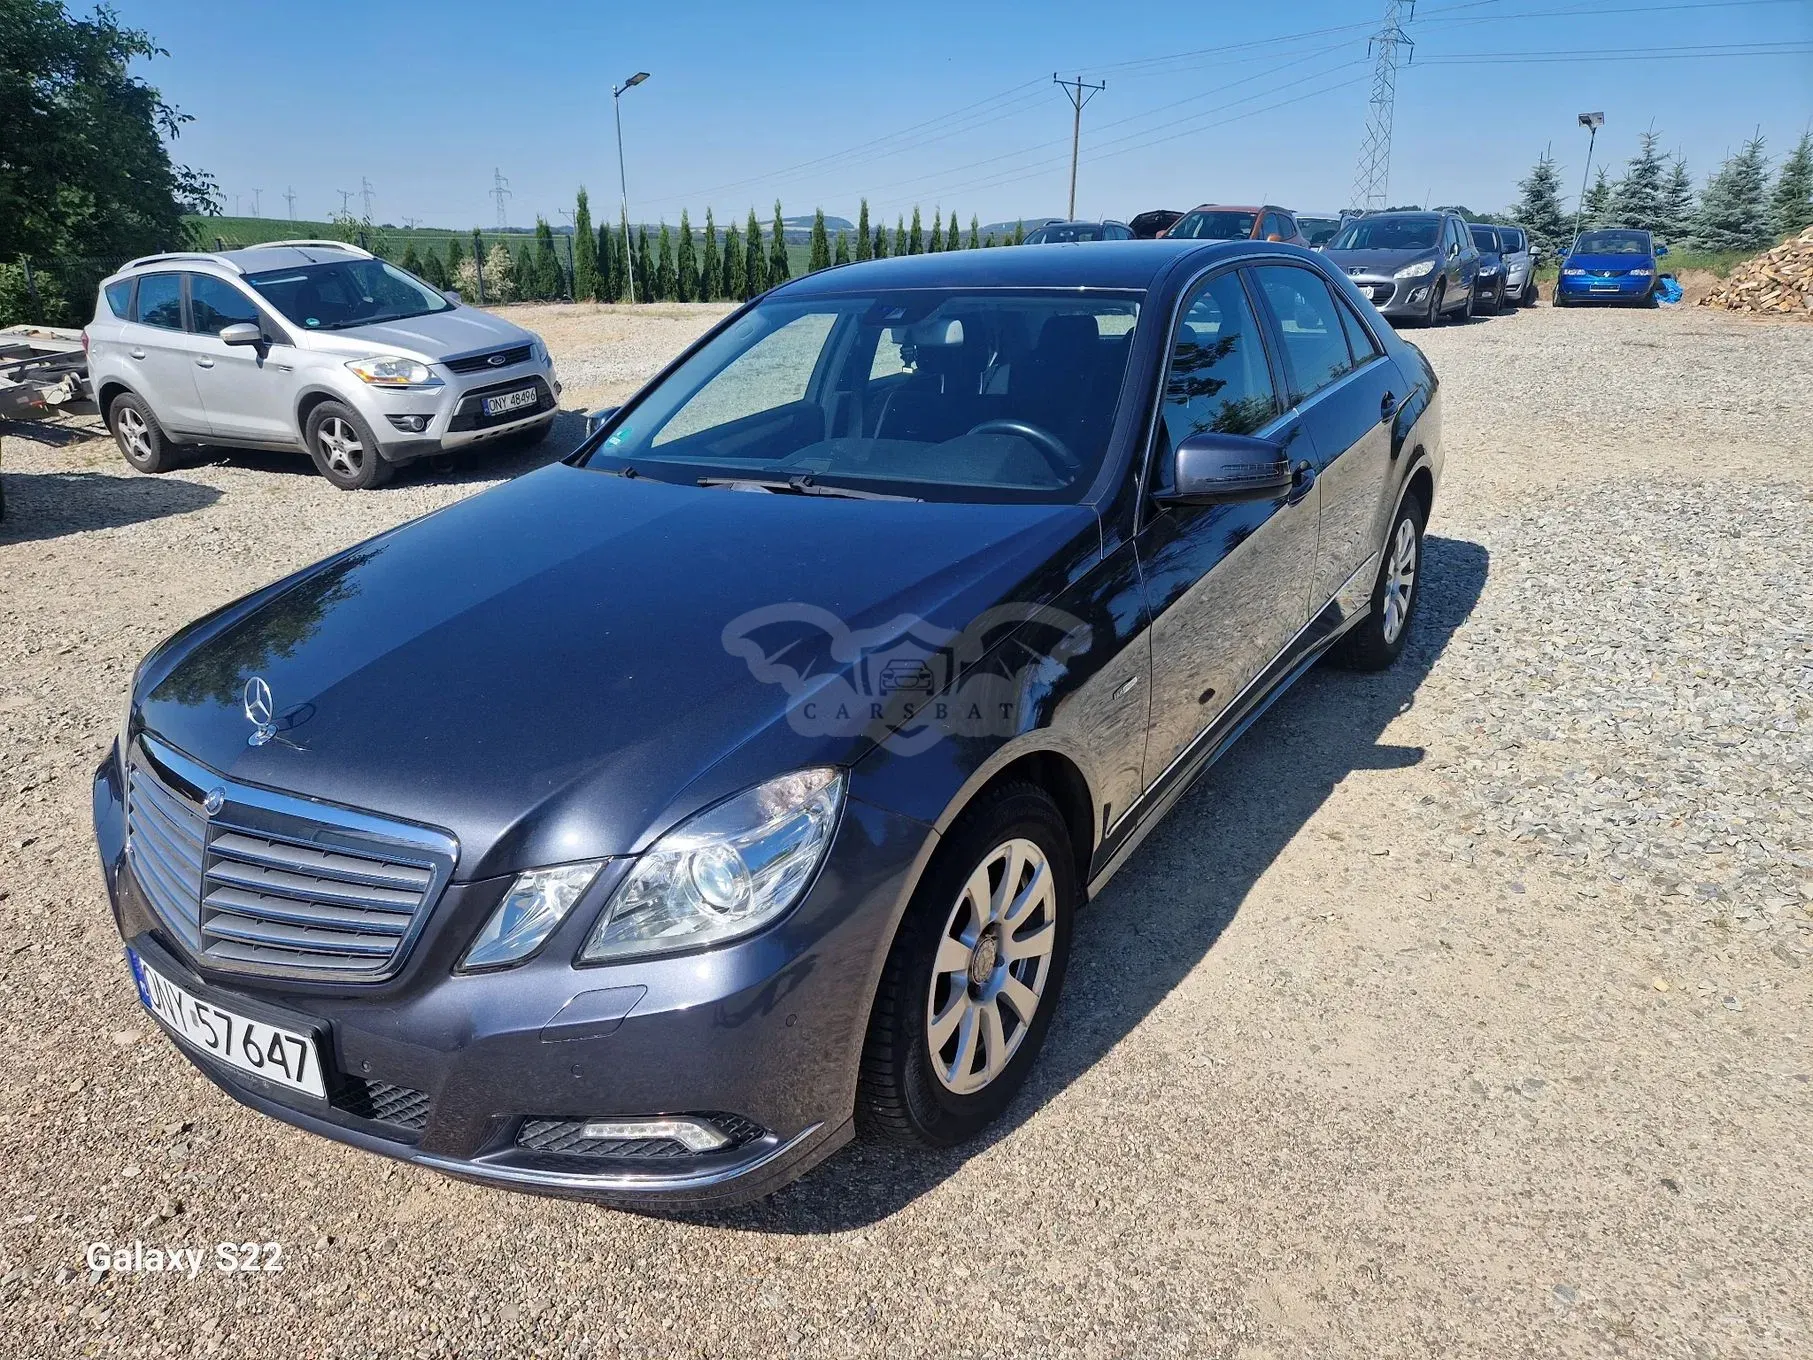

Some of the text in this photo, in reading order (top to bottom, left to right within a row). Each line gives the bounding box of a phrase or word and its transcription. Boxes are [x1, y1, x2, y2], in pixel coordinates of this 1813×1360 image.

[490, 390, 536, 412] ONY 48496
[143, 964, 188, 1032] ONY
